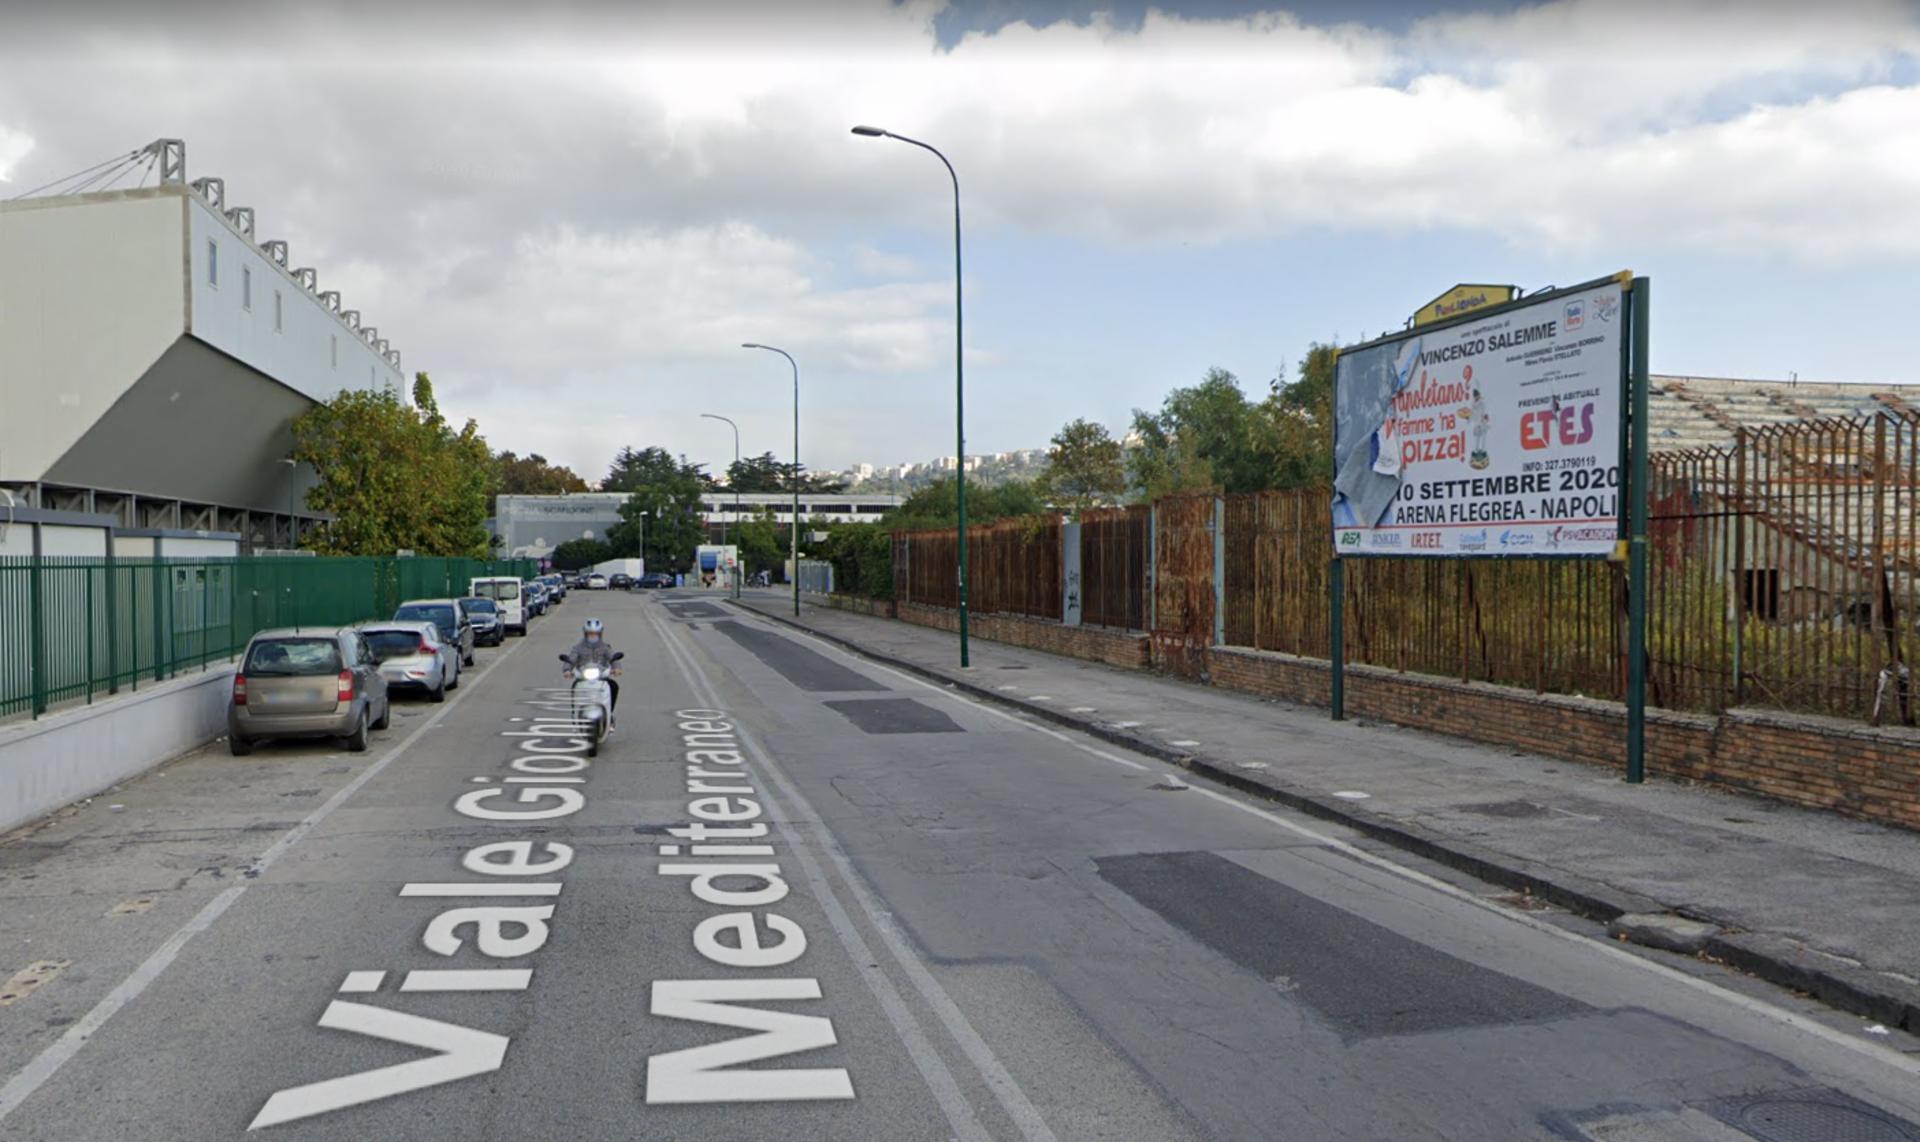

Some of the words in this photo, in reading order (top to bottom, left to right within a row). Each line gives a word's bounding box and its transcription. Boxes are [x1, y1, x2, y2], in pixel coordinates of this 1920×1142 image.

[1421, 339, 1485, 366] VINCENZO
[1488, 321, 1556, 352] SALEMME
[1520, 402, 1594, 451] ETES
[1402, 430, 1466, 470] pizza!
[1522, 461, 1543, 472] INFO:
[1420, 473, 1550, 500] SETTEMBRE
[1559, 466, 1618, 491] 2020
[1396, 504, 1446, 524] ARENA
[1450, 500, 1525, 523] FLEGREA
[1541, 494, 1616, 519] NAPOLI
